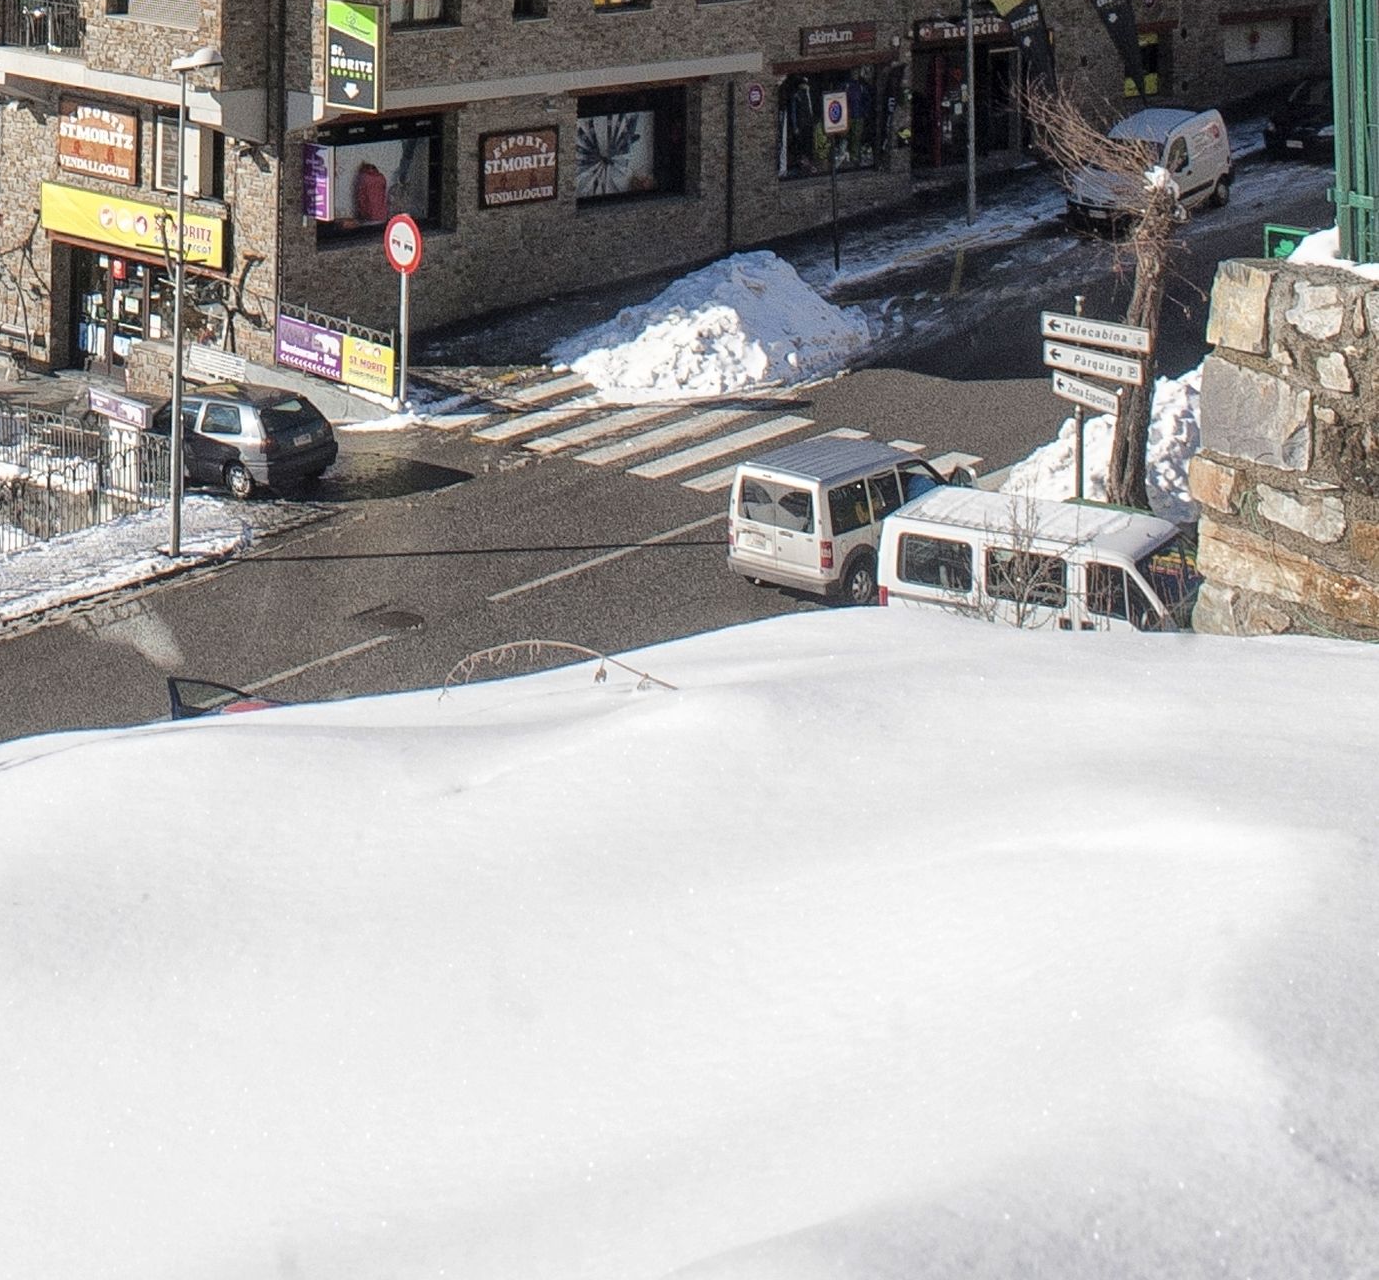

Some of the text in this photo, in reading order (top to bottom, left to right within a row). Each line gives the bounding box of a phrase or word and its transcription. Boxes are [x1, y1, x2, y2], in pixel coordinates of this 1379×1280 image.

[330, 56, 373, 74] MORITZ
[492, 134, 549, 160] ESPORTS
[1064, 322, 1127, 343] Telecabina
[1074, 354, 1123, 377] Pàrquing
